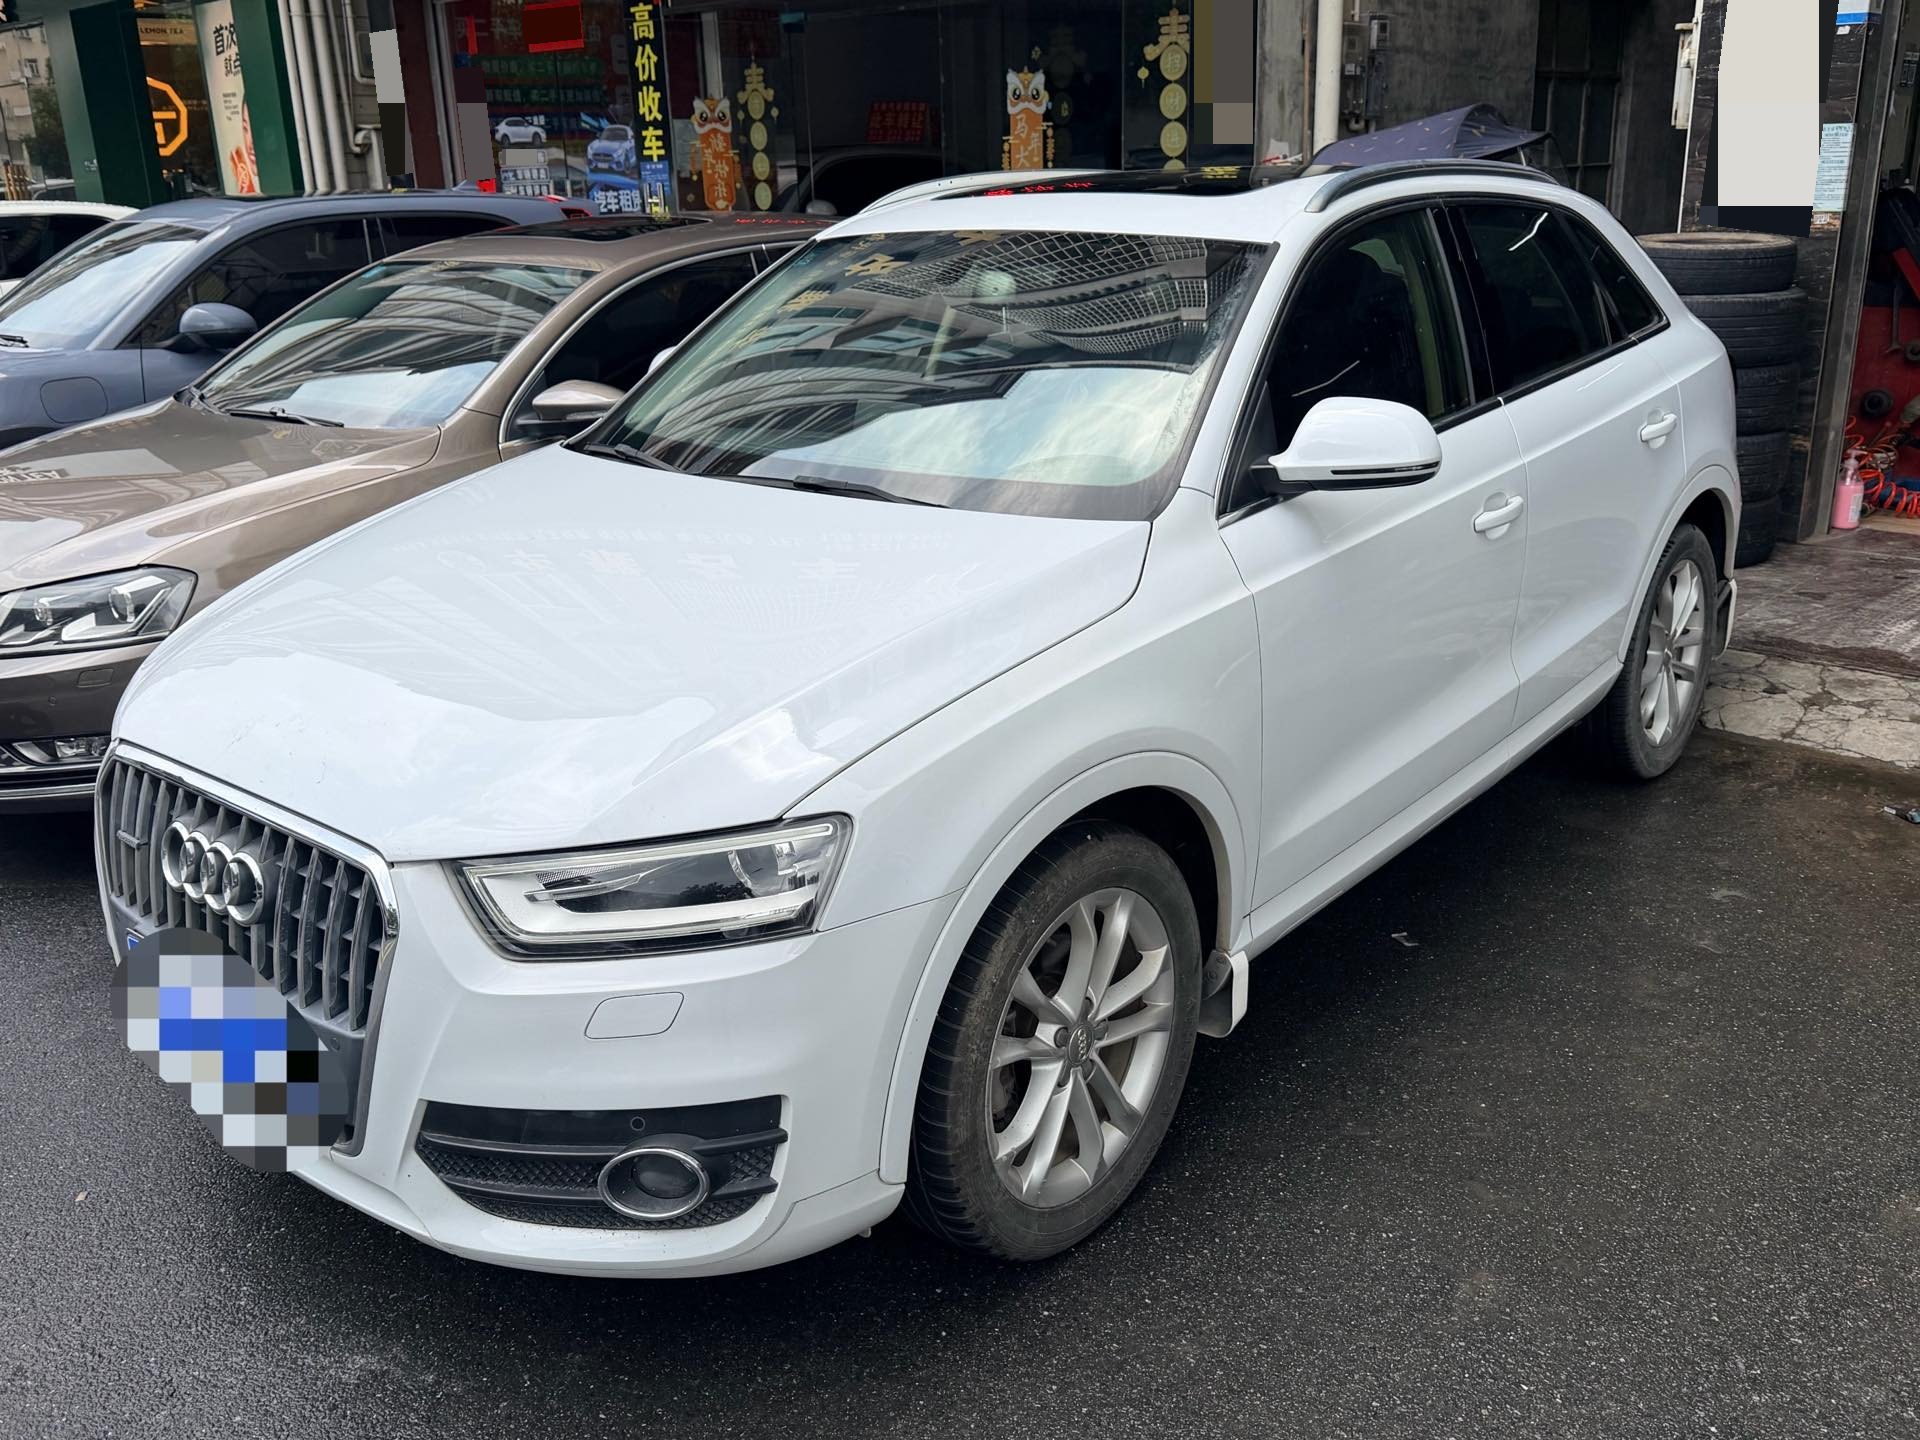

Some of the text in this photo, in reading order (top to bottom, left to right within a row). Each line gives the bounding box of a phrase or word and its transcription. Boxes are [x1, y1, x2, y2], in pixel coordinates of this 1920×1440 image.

[140, 26, 167, 34] LEMON
[629, 3, 665, 162] 高价收车
